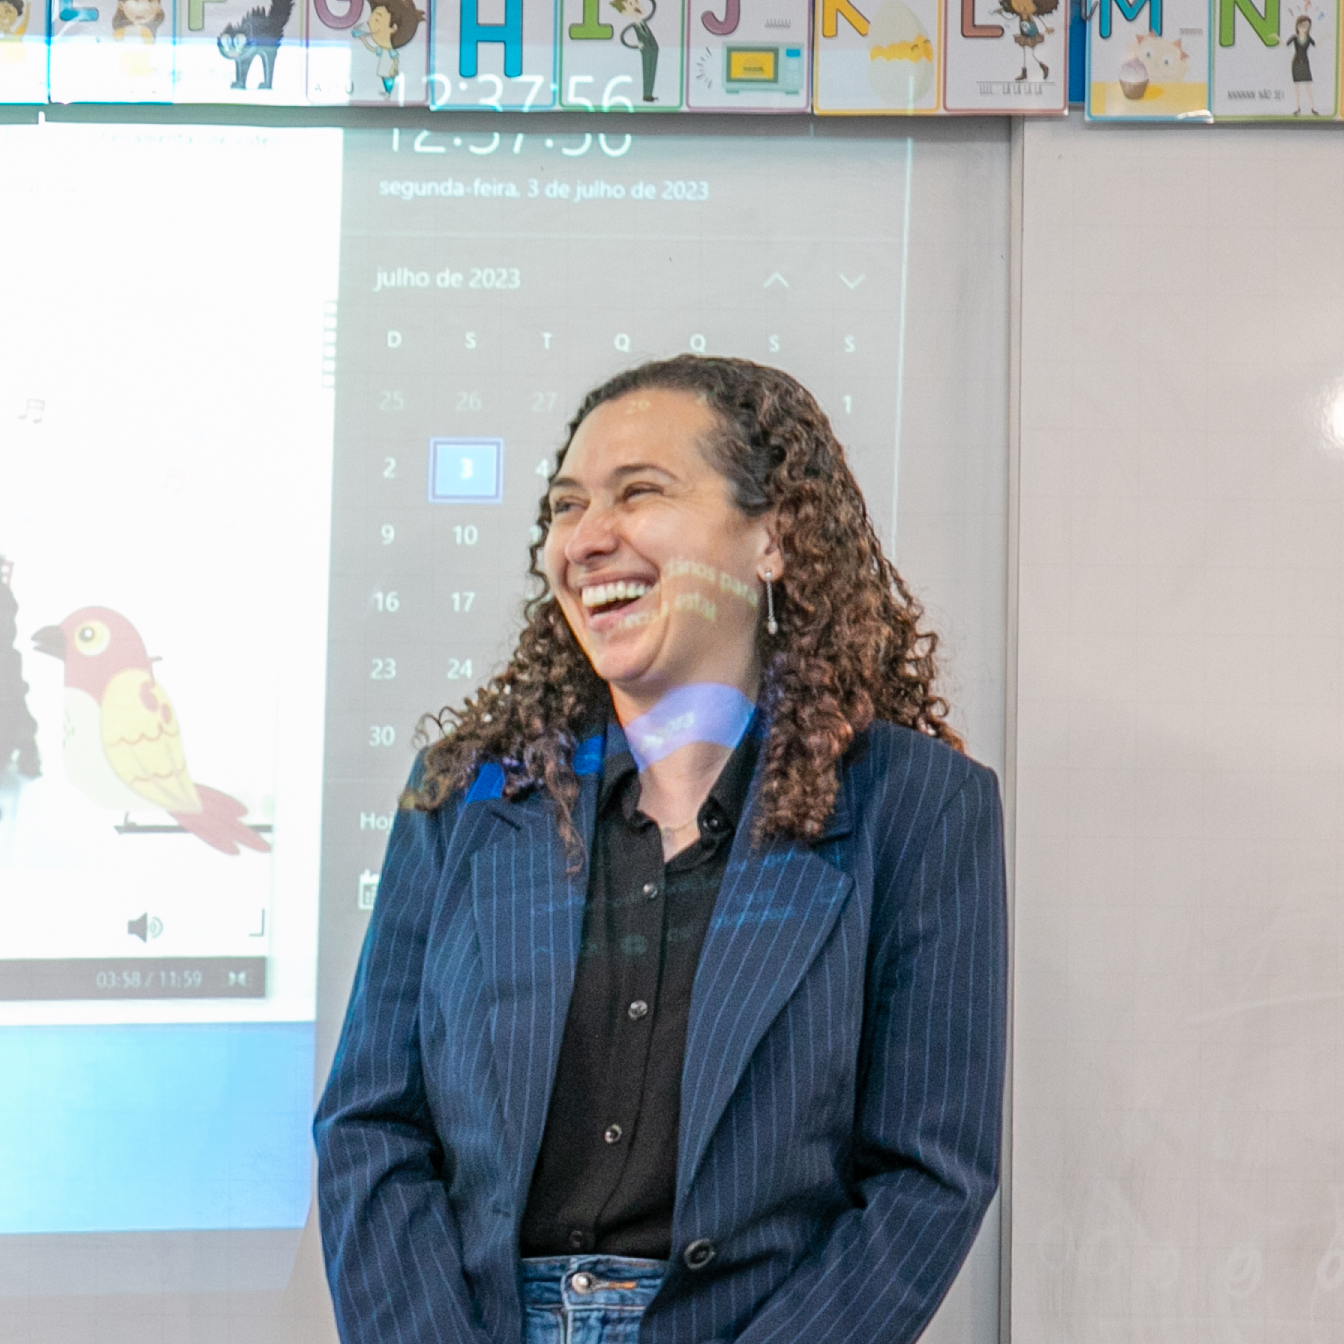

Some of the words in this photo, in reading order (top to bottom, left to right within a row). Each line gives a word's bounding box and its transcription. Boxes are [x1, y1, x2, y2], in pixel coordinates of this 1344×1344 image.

[1217, 0, 1280, 47] N
[458, 0, 523, 78] H
[527, 179, 540, 198] 3
[544, 179, 571, 199] de
[573, 179, 626, 204] julho
[629, 180, 656, 200] de
[660, 180, 710, 201] 2023
[372, 266, 431, 293] julho
[436, 267, 464, 289] de
[469, 267, 522, 290] 2023
[387, 330, 402, 349] D
[465, 331, 477, 350] S
[542, 332, 553, 351] T
[614, 333, 631, 353] Q
[690, 334, 707, 354] Q
[769, 335, 781, 354] S
[844, 336, 856, 354] S
[379, 391, 405, 411] 25
[456, 391, 482, 411] 26
[531, 392, 557, 412] 27
[843, 394, 853, 414] 1
[382, 458, 397, 478] 2
[460, 459, 473, 479] 3
[534, 457, 549, 480] 4
[381, 525, 395, 545] 9
[453, 525, 479, 545] 10
[375, 592, 400, 613] 16
[452, 592, 476, 613] 17
[370, 659, 397, 680] 23
[447, 659, 473, 680] 24
[368, 726, 395, 747] 30
